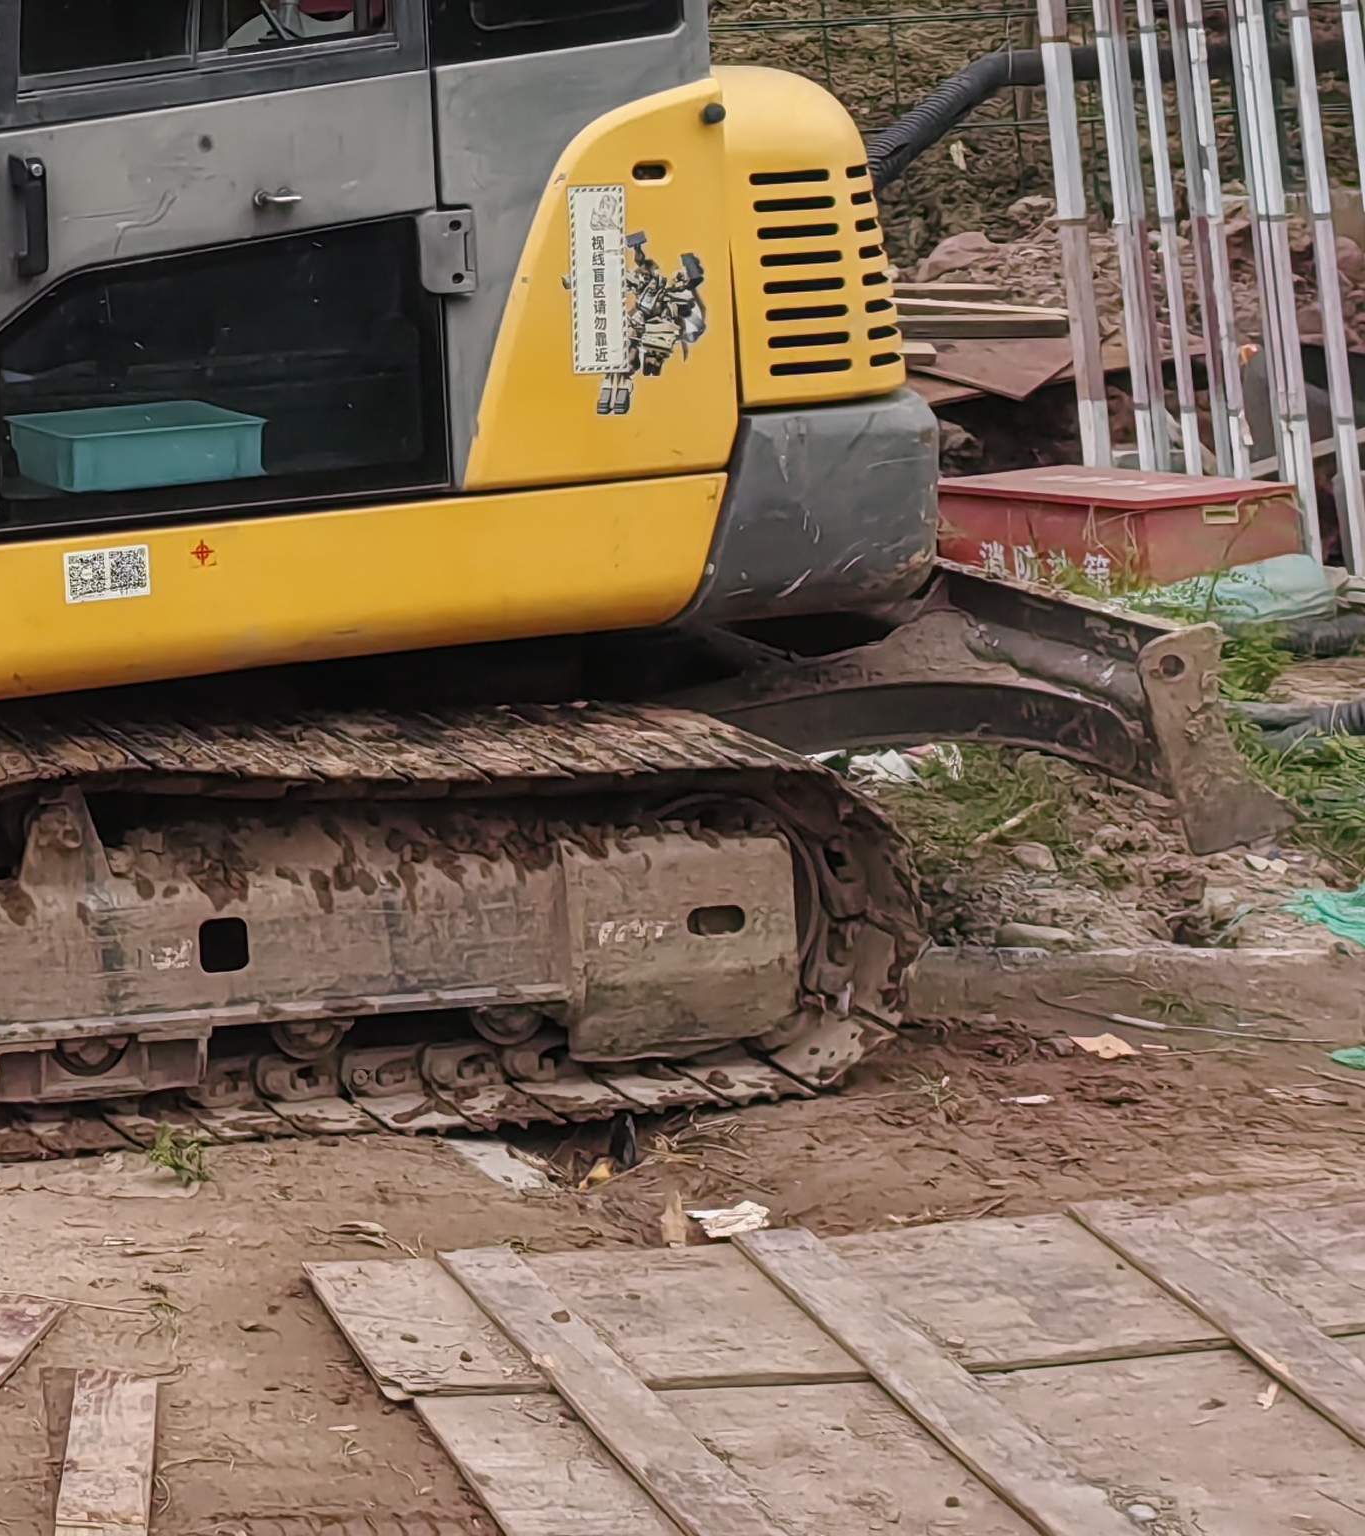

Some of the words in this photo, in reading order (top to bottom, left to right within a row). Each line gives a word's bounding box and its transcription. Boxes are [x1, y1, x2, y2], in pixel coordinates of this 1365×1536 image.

[591, 235, 608, 362] 视线盲区请勿靠近
